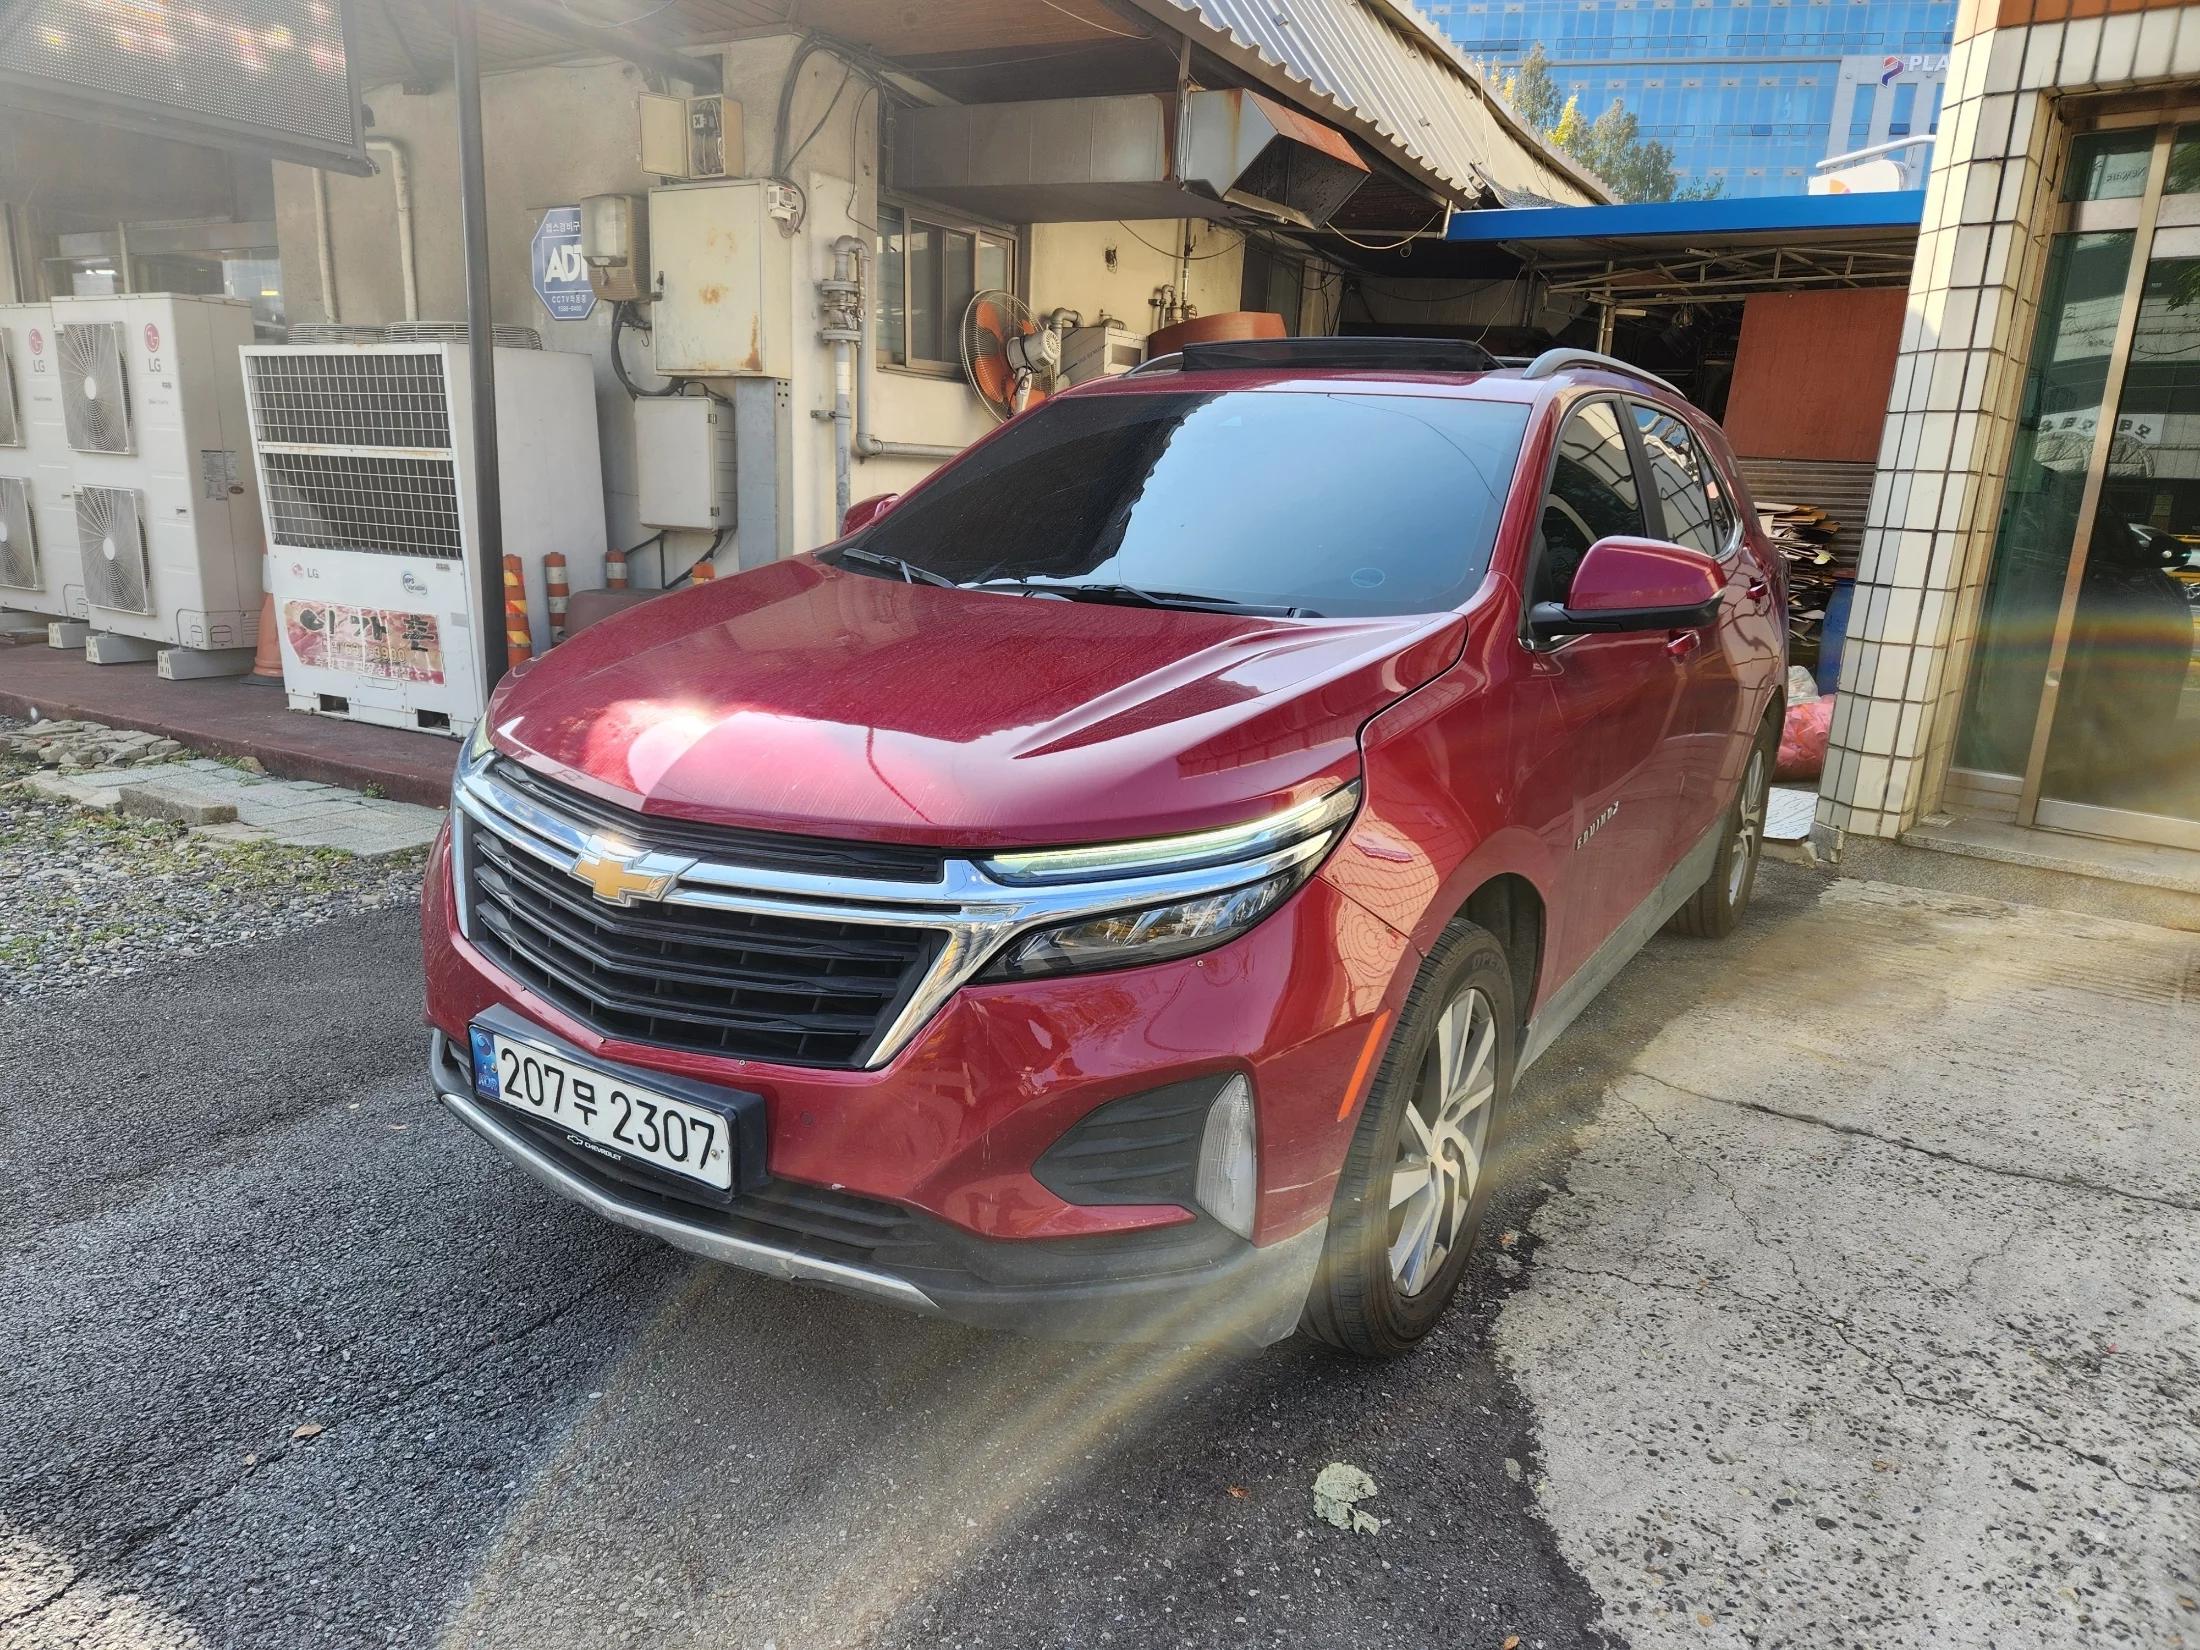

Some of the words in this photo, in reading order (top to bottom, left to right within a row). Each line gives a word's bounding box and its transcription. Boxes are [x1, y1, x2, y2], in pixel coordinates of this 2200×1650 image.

[544, 245, 588, 282] ADT
[34, 360, 45, 372] LG
[149, 359, 161, 372] LG
[307, 567, 320, 579] LG
[501, 1047, 597, 1126] 207무
[610, 1090, 715, 1170] 2307
[584, 1141, 621, 1161] CHEVROLET
